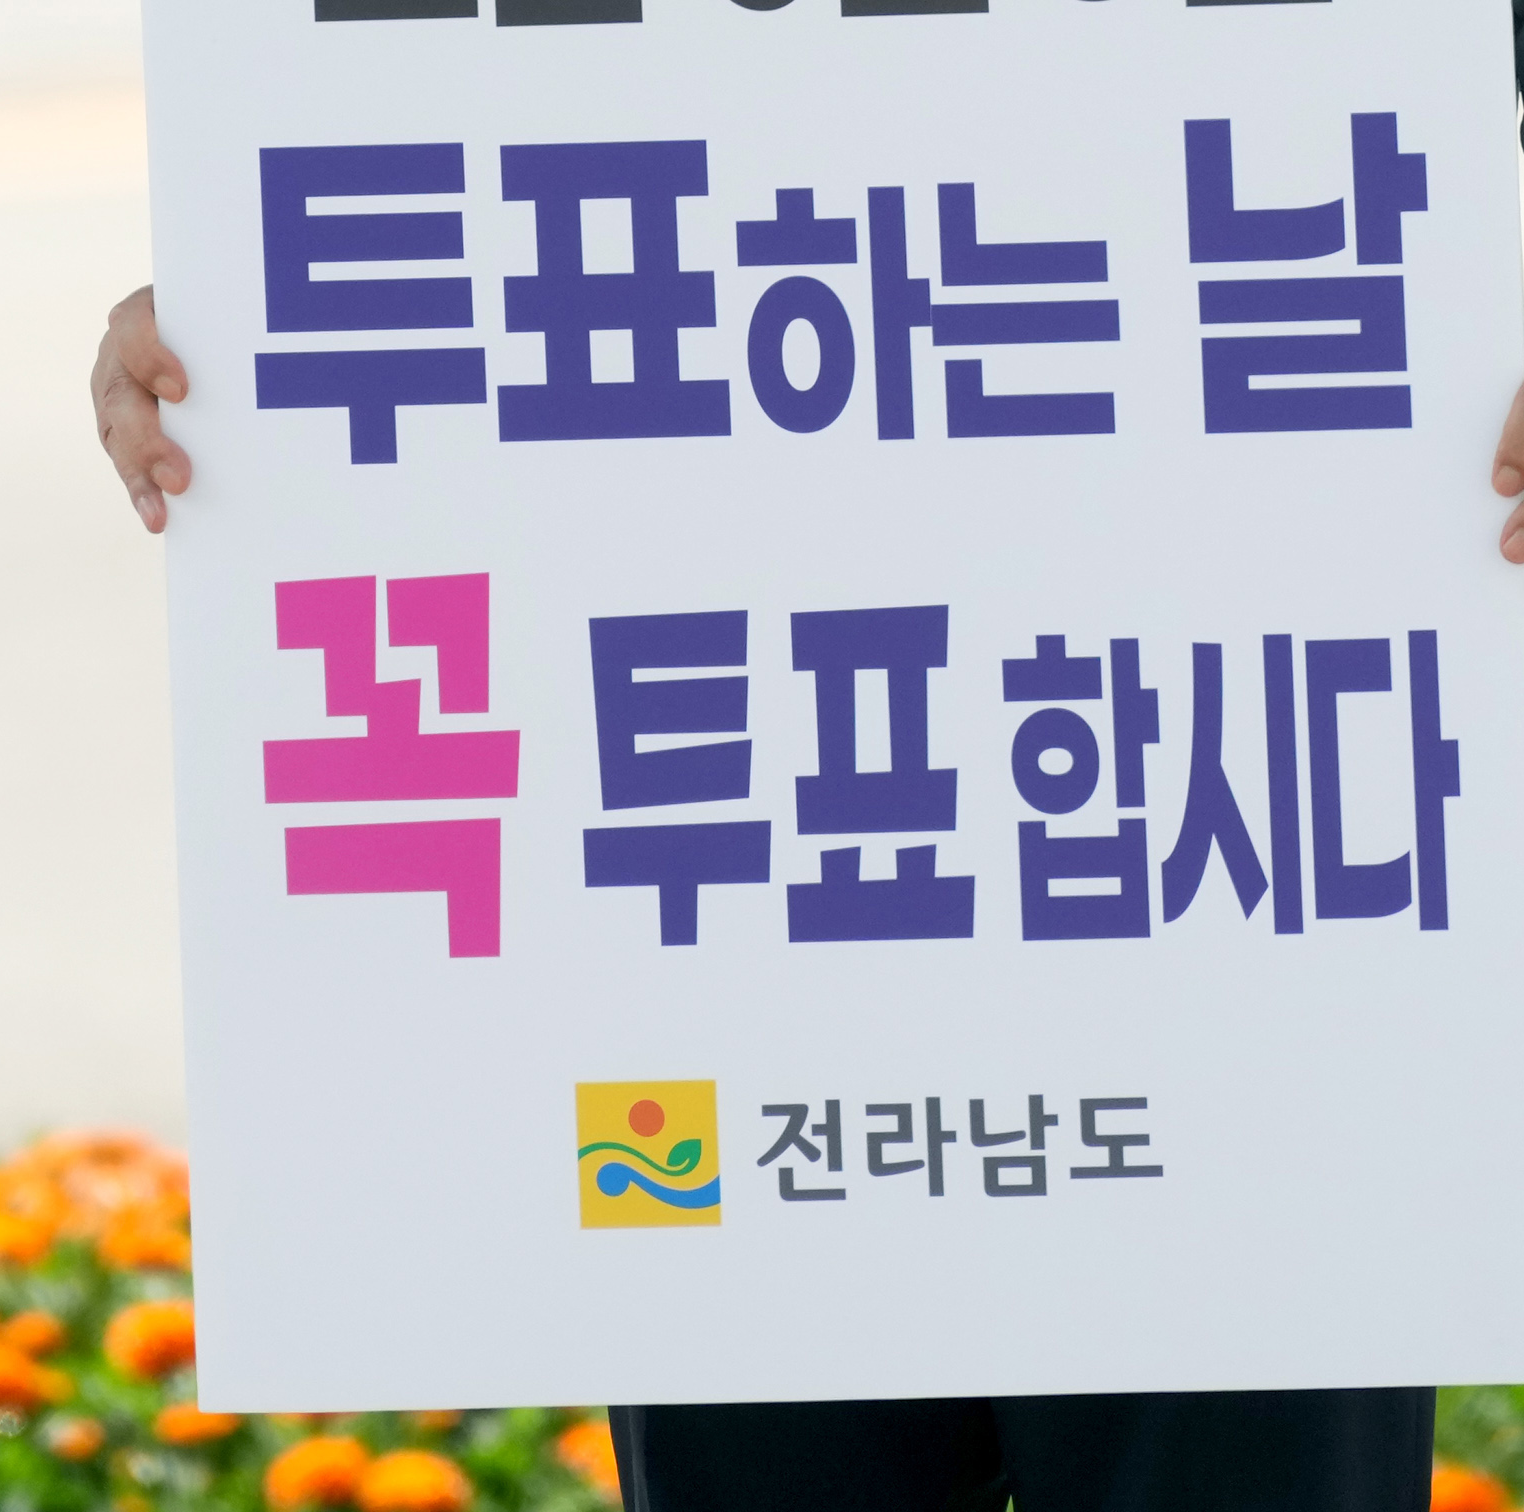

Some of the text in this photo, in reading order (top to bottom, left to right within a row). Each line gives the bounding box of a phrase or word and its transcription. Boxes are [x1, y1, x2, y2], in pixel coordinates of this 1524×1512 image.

[255, 112, 1428, 464] 투표하는 날
[263, 573, 520, 958] 꼭
[757, 1095, 1163, 1201] 전라남도
